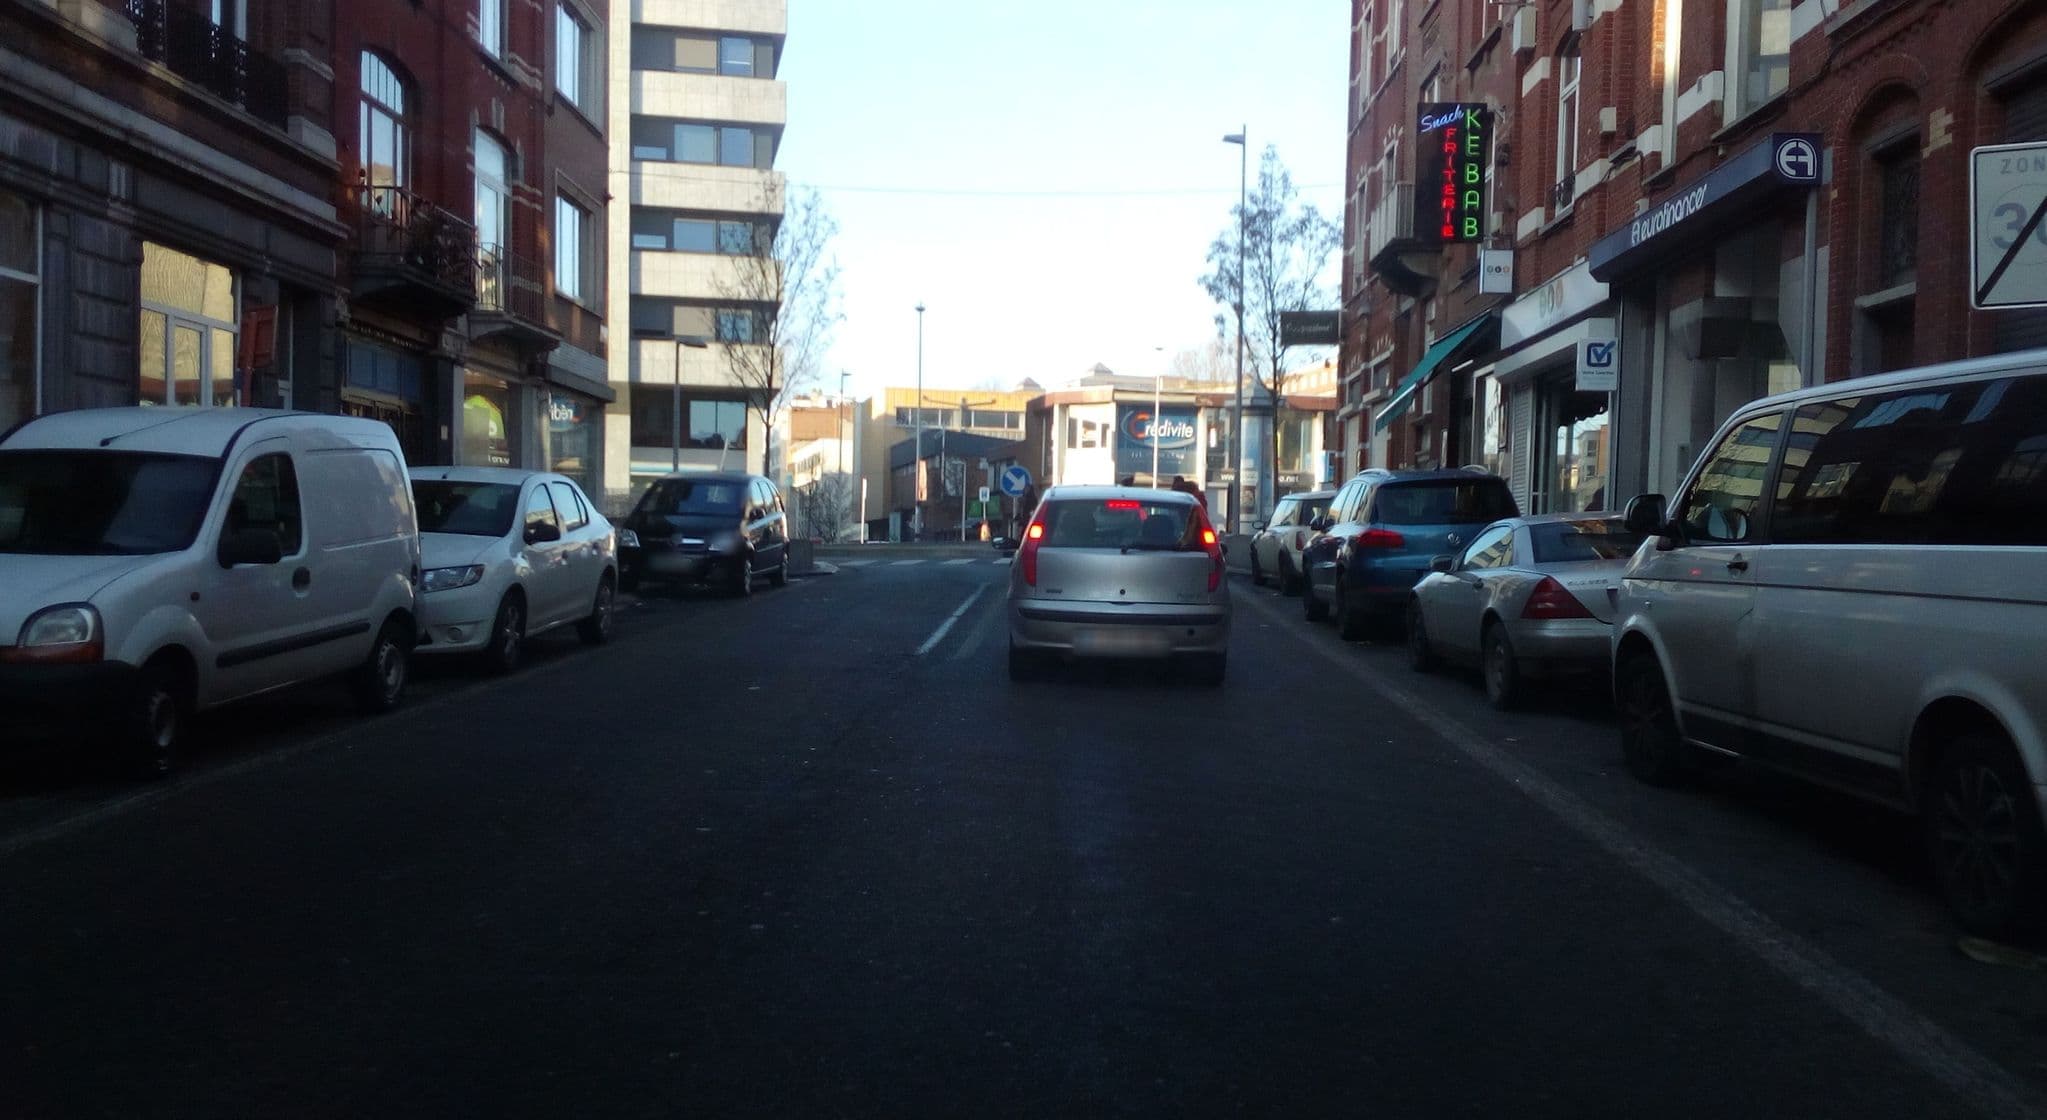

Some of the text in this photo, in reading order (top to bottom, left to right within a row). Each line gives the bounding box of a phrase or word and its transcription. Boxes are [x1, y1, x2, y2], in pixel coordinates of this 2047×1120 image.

[1420, 104, 1464, 132] Snack
[1465, 108, 1481, 237] KEBAB
[1442, 128, 1457, 237] FRITERIE
